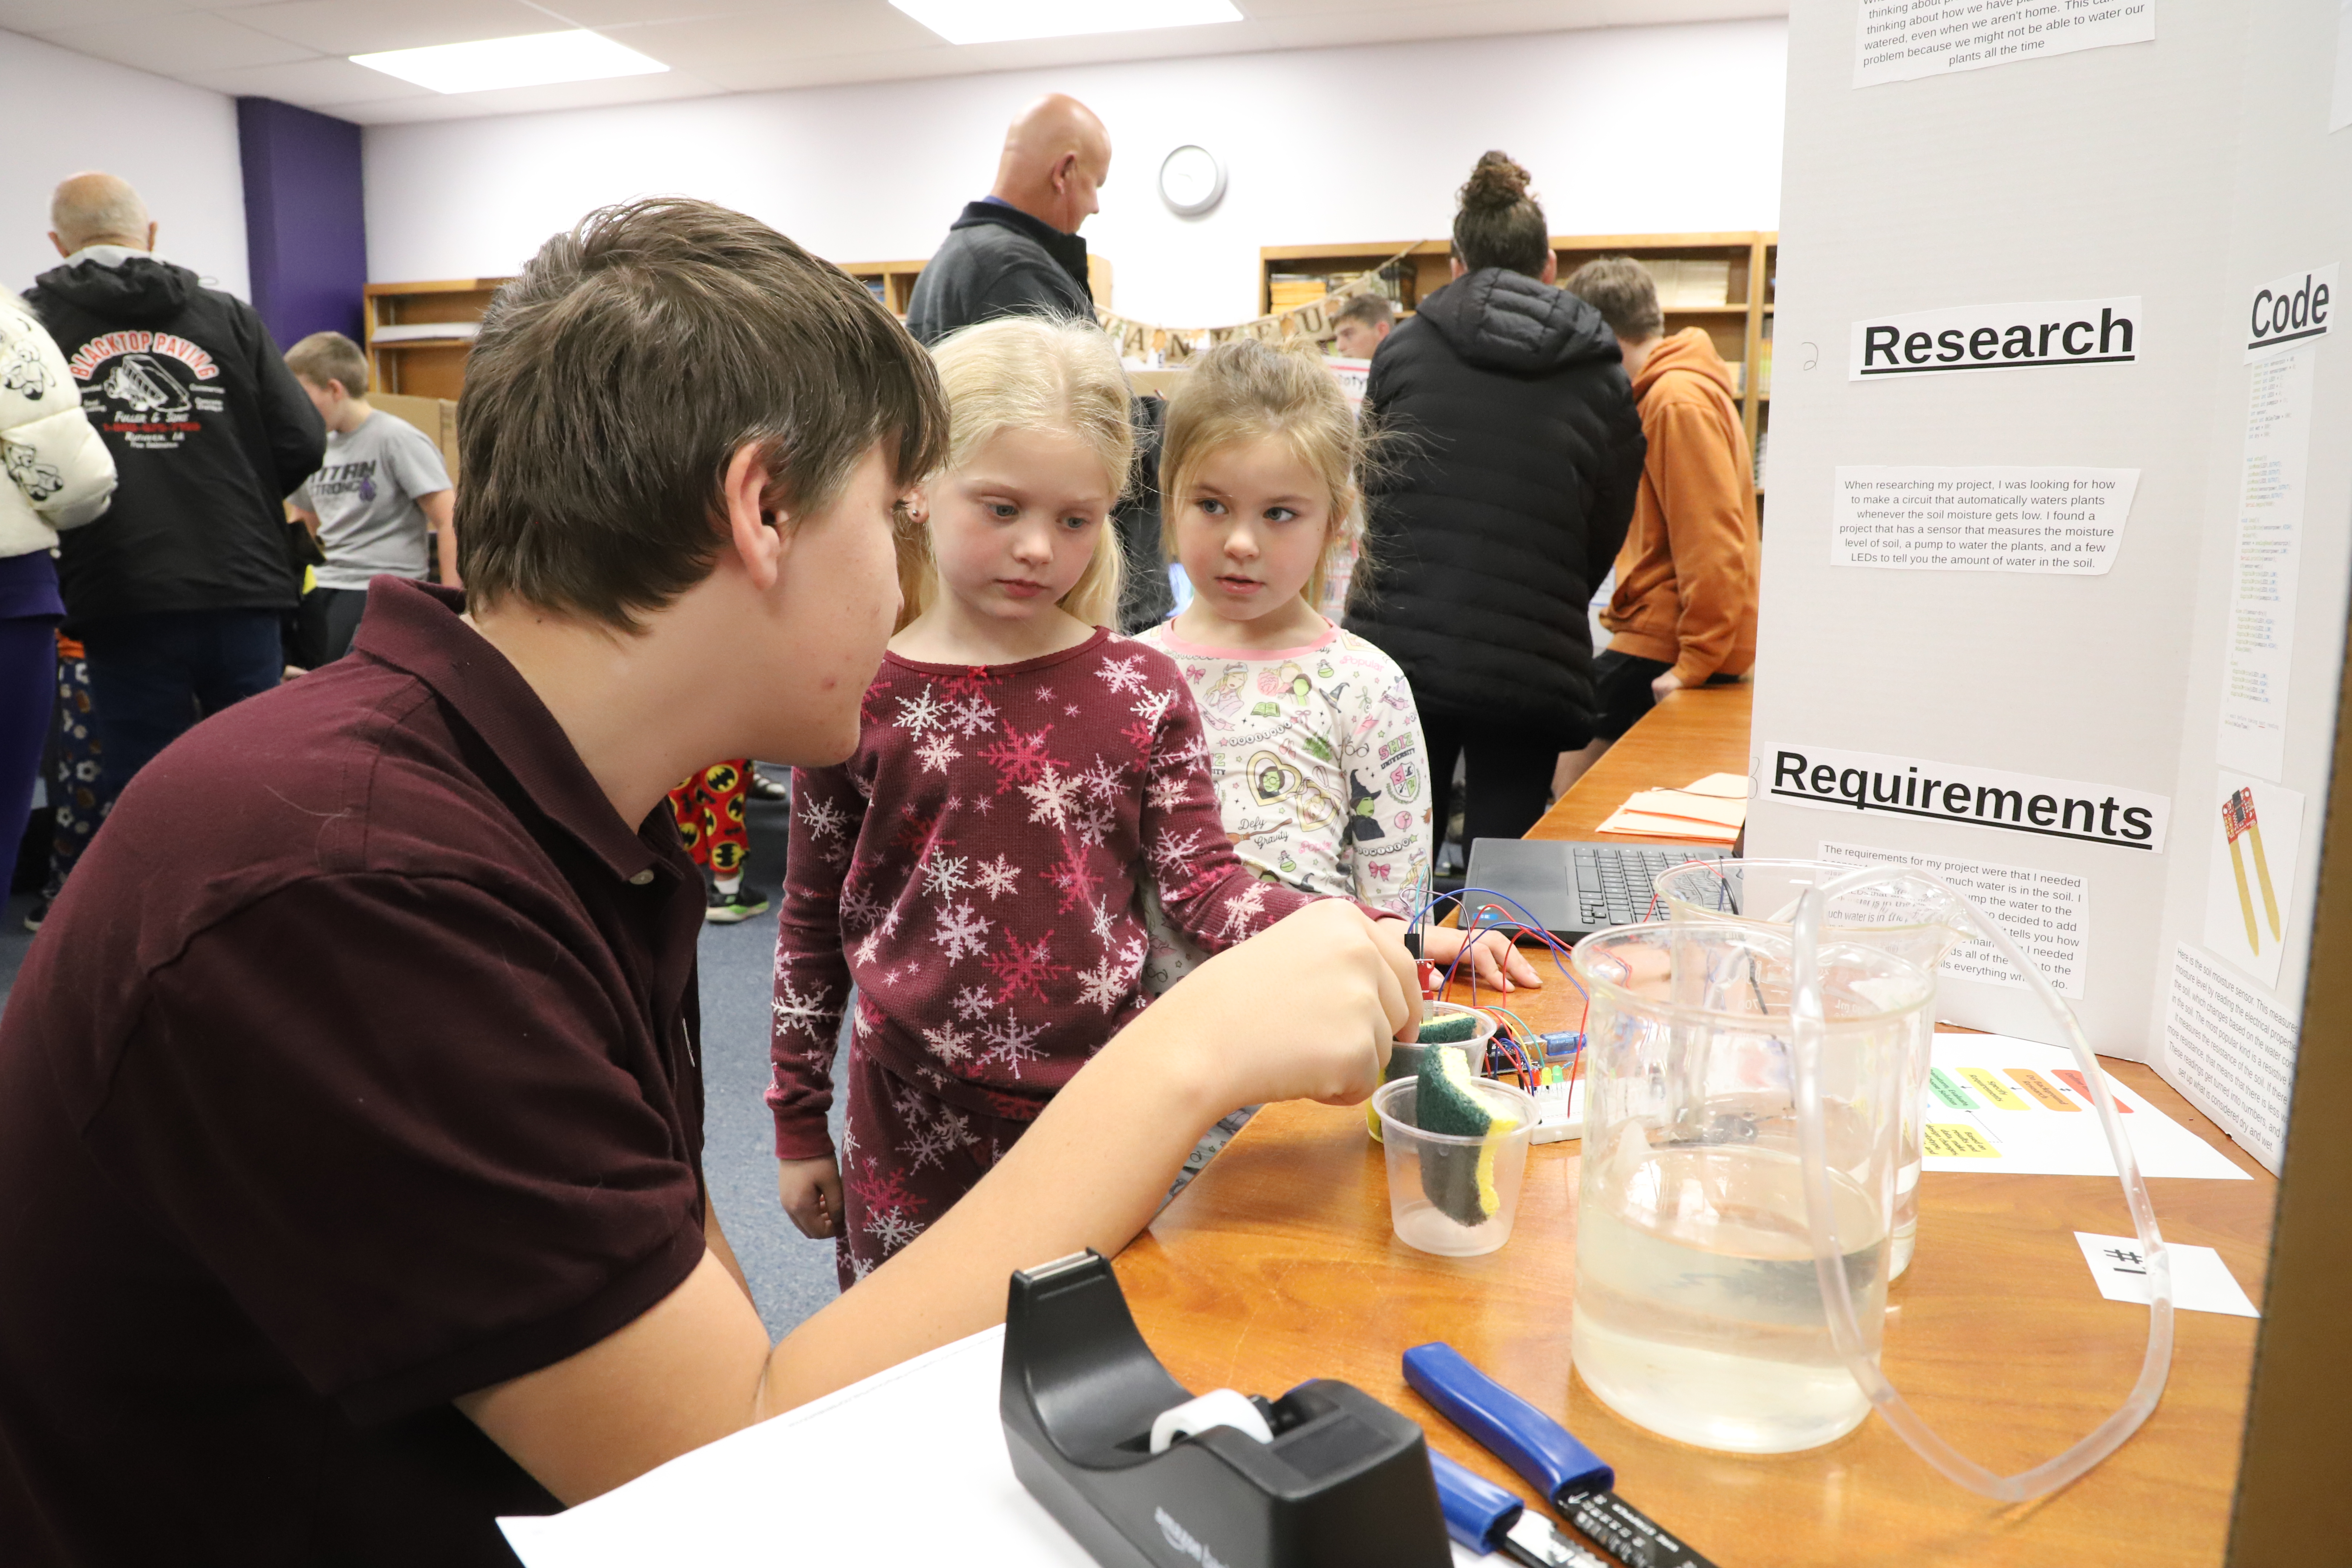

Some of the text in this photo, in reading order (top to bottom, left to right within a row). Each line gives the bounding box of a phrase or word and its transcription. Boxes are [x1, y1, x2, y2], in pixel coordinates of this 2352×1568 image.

[1867, 20, 1906, 34] thinking
[1909, 12, 1939, 26] about
[1942, 8, 1964, 19] how
[1967, 5, 1983, 14] we
[1986, 0, 2013, 10] have
[1869, 4, 1908, 19] thinking
[1911, 0, 1941, 10] about
[1864, 0, 2089, 50] watered, even when we aren't home. This
[1864, 4, 2145, 68] problem because we might not be able to water our
[1949, 40, 2044, 67] plants all the time
[2252, 274, 2329, 338] Code
[1864, 308, 2133, 366] Research
[69, 330, 219, 380] BLACKTOP PAVING
[1845, 481, 1873, 489] When
[1876, 480, 1934, 491] researching
[1938, 482, 1953, 491] my
[1956, 480, 1994, 491] project,
[1999, 480, 2001, 488] I
[2030, 479, 2069, 491] looking
[2073, 479, 2088, 489] for
[2092, 479, 2116, 489] how
[1864, 495, 1890, 504] make
[1902, 495, 1932, 504] circuit
[1935, 495, 1955, 504] that
[1958, 495, 2027, 507] automatically
[2030, 496, 2067, 504] waters
[2071, 495, 2105, 507] plants
[1857, 510, 1905, 519] whenever
[1908, 510, 1923, 519] the
[1927, 510, 1944, 519] soil
[1947, 510, 1992, 519] moisture
[1995, 511, 2018, 522] gets
[2022, 511, 2042, 520] low.
[2047, 511, 2049, 520] I
[2053, 511, 2084, 520] found
[1840, 524, 1872, 534] project
[1875, 524, 1894, 533] that
[1897, 524, 1914, 533] has
[1965, 525, 1985, 534] that
[2044, 526, 2061, 536] the
[2066, 527, 2114, 536] moisture
[1845, 538, 1867, 547] level
[1870, 539, 1880, 547] of
[1882, 539, 1901, 549] soil,
[1914, 542, 1943, 551] pump
[1959, 541, 1988, 550] water
[1991, 541, 2007, 550] the
[2011, 541, 2046, 553] plants,
[2050, 542, 2071, 551] and
[2086, 542, 2106, 552] few
[1851, 553, 1877, 562] LEDs
[1893, 554, 1907, 562] tell
[1910, 556, 1928, 565] you
[1932, 554, 1947, 564] the
[1993, 556, 2003, 565] of
[2006, 557, 2036, 566] water
[2040, 557, 2049, 566] in
[2052, 557, 2069, 567] the
[2073, 558, 2095, 568] soil.
[1340, 655, 1385, 672] Popular
[1230, 721, 1292, 746] TOGETHER
[1379, 732, 1414, 761] SHIZ
[1381, 748, 1415, 769] UNIVERSITY
[1774, 750, 2153, 840] Requirements
[1238, 816, 1265, 830] Defy
[1254, 831, 1289, 849] Gravity
[1824, 845, 1842, 854] The
[1845, 849, 1907, 864] requirements
[1911, 856, 1923, 865] for
[1927, 860, 1942, 870] my
[1945, 863, 1979, 873] project
[1982, 868, 2007, 877] were
[2011, 870, 2030, 880] that
[2041, 876, 2080, 887] needed
[1946, 877, 2081, 902] much water is in the soil. I
[1990, 896, 2072, 916] the water to the
[1998, 912, 2076, 931] decided to add
[2010, 929, 2079, 946] tells you how
[1954, 964, 2006, 980] everything
[2052, 979, 2067, 989] do.
[2177, 948, 2189, 962] Here
[2189, 955, 2194, 965] is
[2203, 966, 2212, 977] soil
[2212, 972, 2234, 992] moisture
[2235, 987, 2254, 1006] sensor.
[2257, 998, 2268, 1015] This
[2269, 1009, 2298, 1034] measures
[1969, 1075, 2003, 1101] Requirements
[1988, 1081, 2007, 1095] Specify
[2023, 1081, 2049, 1099] Research
[2037, 1081, 2069, 1104] Background
[2178, 1068, 2273, 1152] set up what is considered dry and wet.
